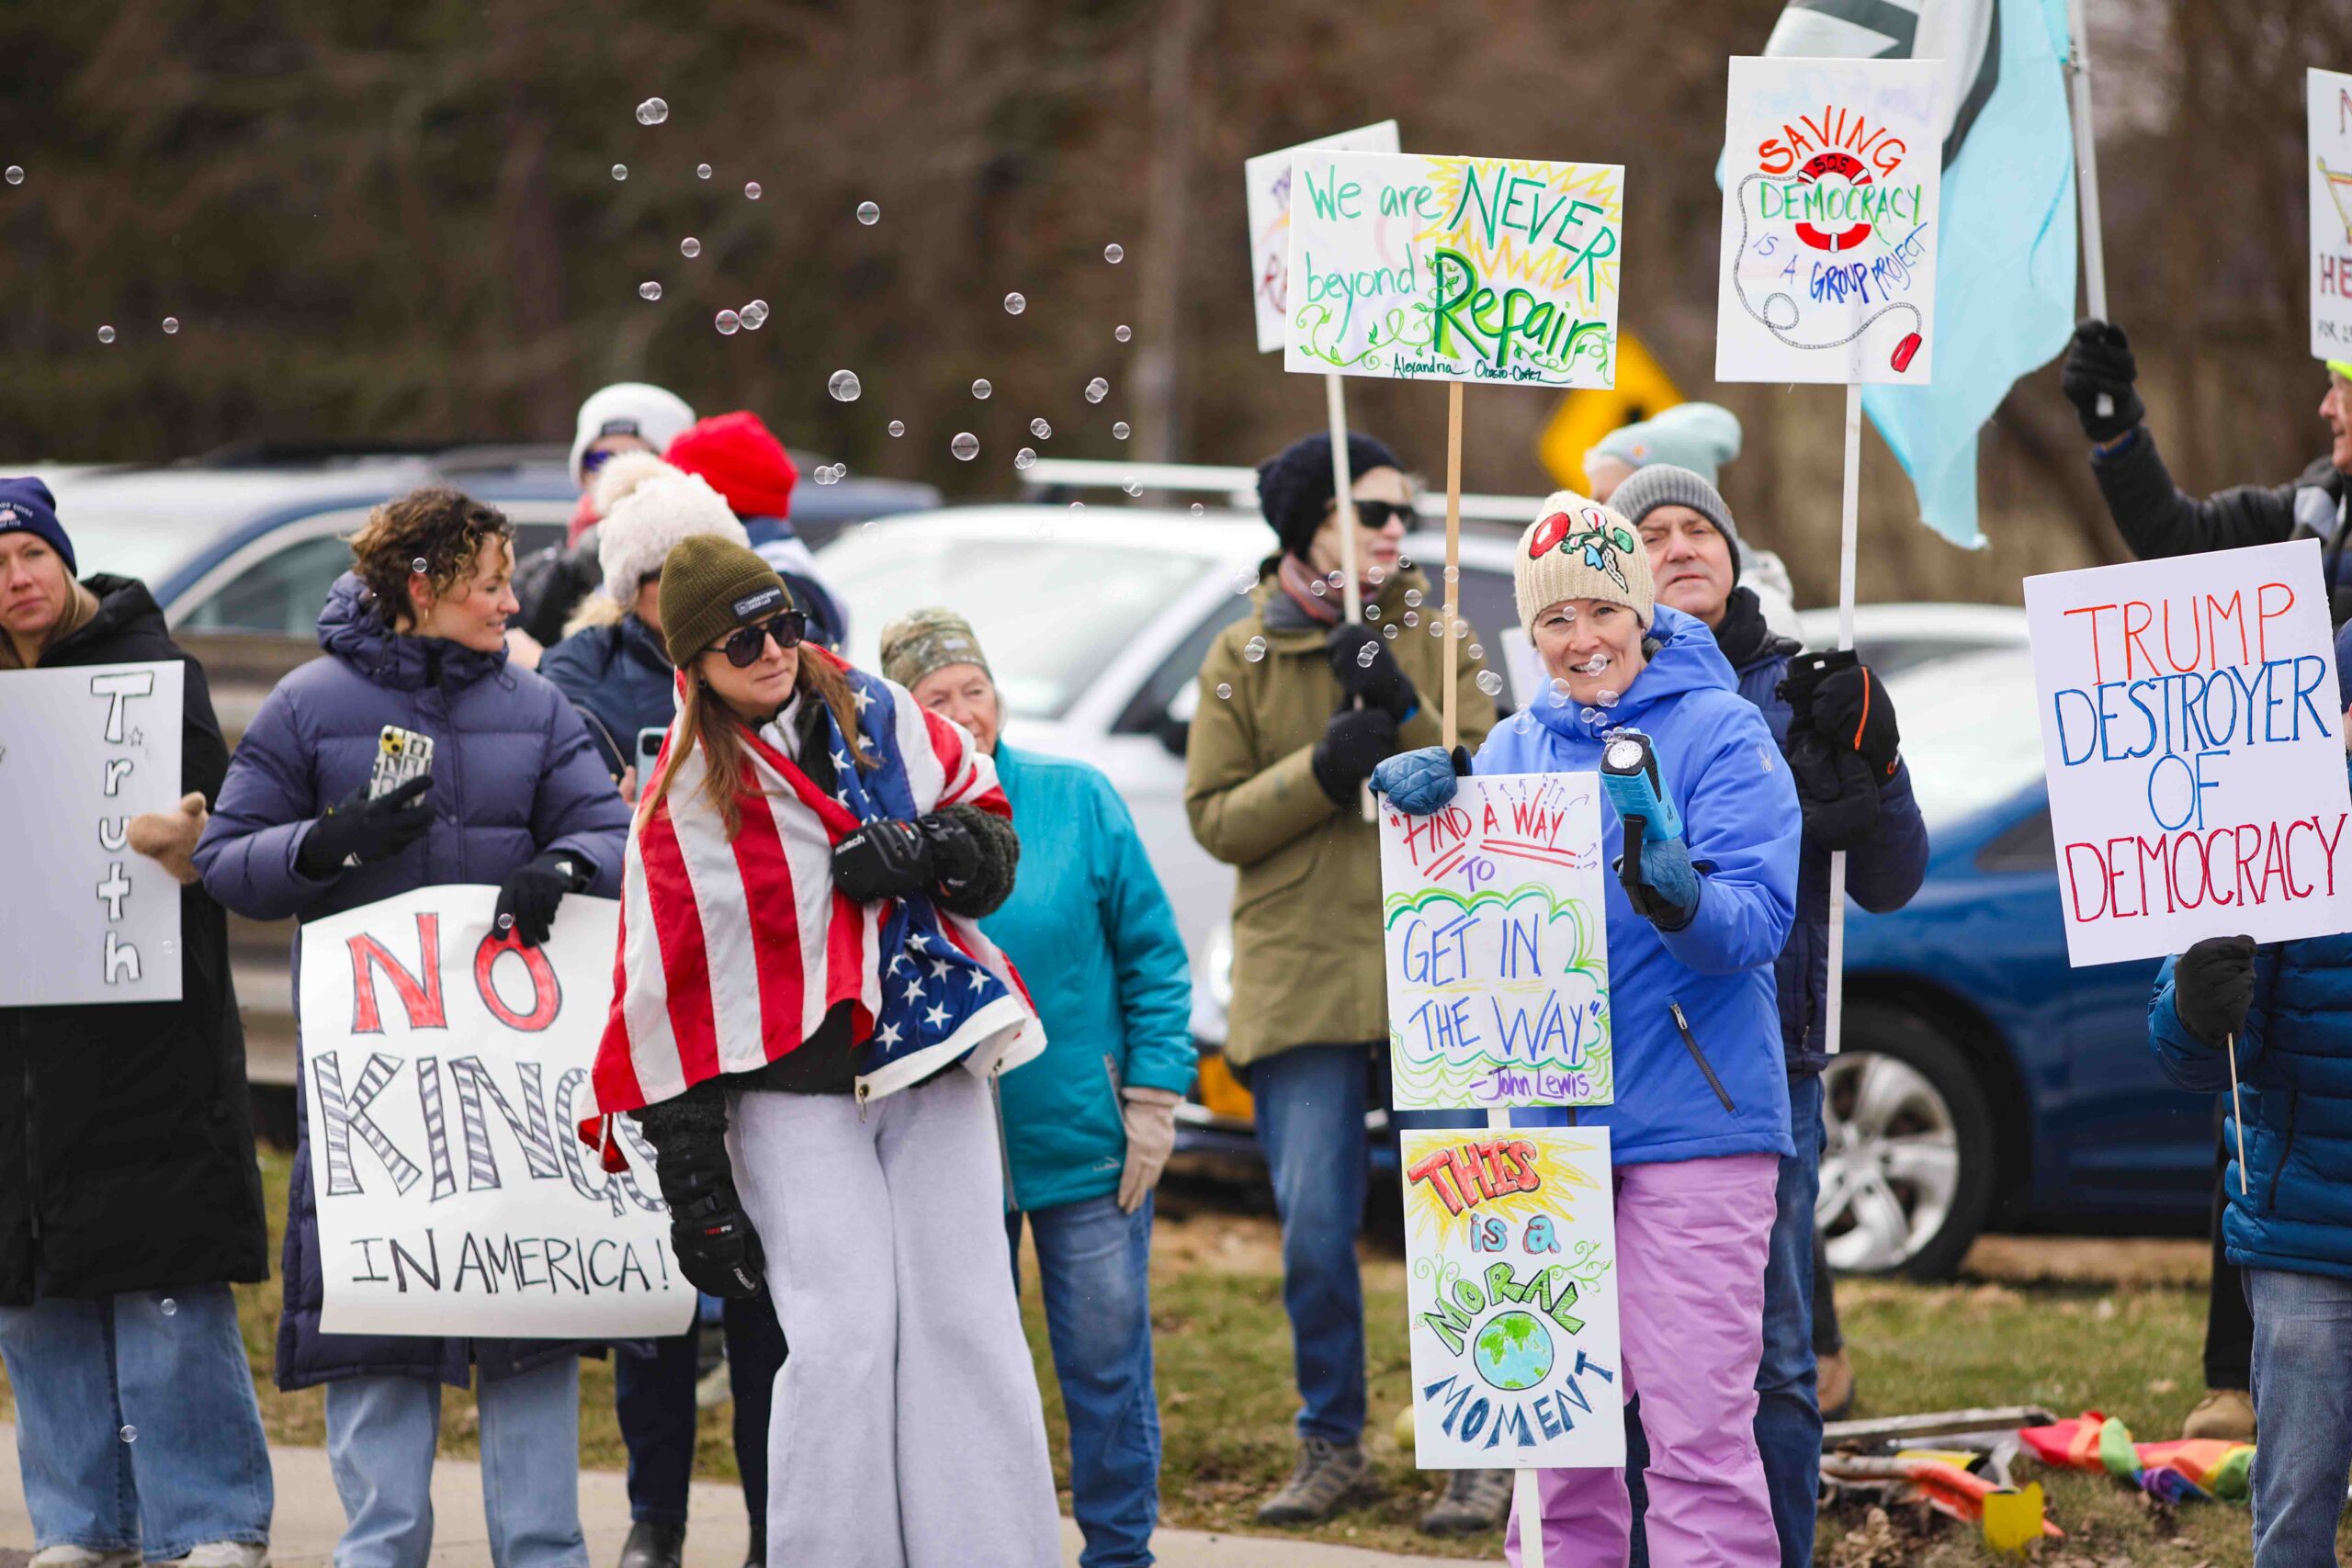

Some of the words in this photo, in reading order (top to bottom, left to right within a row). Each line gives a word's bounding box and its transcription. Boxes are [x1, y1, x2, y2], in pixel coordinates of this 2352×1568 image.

[1758, 105, 1905, 177] SAVING
[1305, 164, 1361, 220] We
[1378, 183, 1442, 220] are
[1448, 164, 1615, 302] NEVER
[1761, 182, 1922, 246] DEMOCRACY
[1753, 232, 1779, 255] IS
[1780, 254, 1798, 284] A
[1810, 261, 1869, 304] GROUP
[1872, 222, 1928, 301] PROJECT
[1306, 243, 1416, 344] beyond
[1433, 246, 1608, 367] Repair
[2064, 582, 2295, 686] TRUMP
[2054, 655, 2332, 766] DESTROYER
[91, 671, 154, 984] Truth
[1483, 803, 1500, 835] A
[1512, 787, 1565, 850] WAY
[2148, 750, 2231, 831] OF
[1458, 856, 1495, 893] TO
[2065, 813, 2348, 922] DEMOCRACY
[346, 912, 562, 1035] NO
[1403, 915, 1481, 987] GET
[1500, 913, 1542, 979] IN
[1408, 996, 1481, 1052] THE
[1536, 1066, 1590, 1100] Lewis
[1407, 1139, 1541, 1217] THIS
[350, 1228, 442, 1293] IN
[454, 1231, 671, 1295] AMERICA!
[1470, 1213, 1508, 1253] is
[1522, 1214, 1562, 1255] a
[1424, 1262, 1586, 1358] MORAL
[1423, 1349, 1614, 1451] MOMENT
